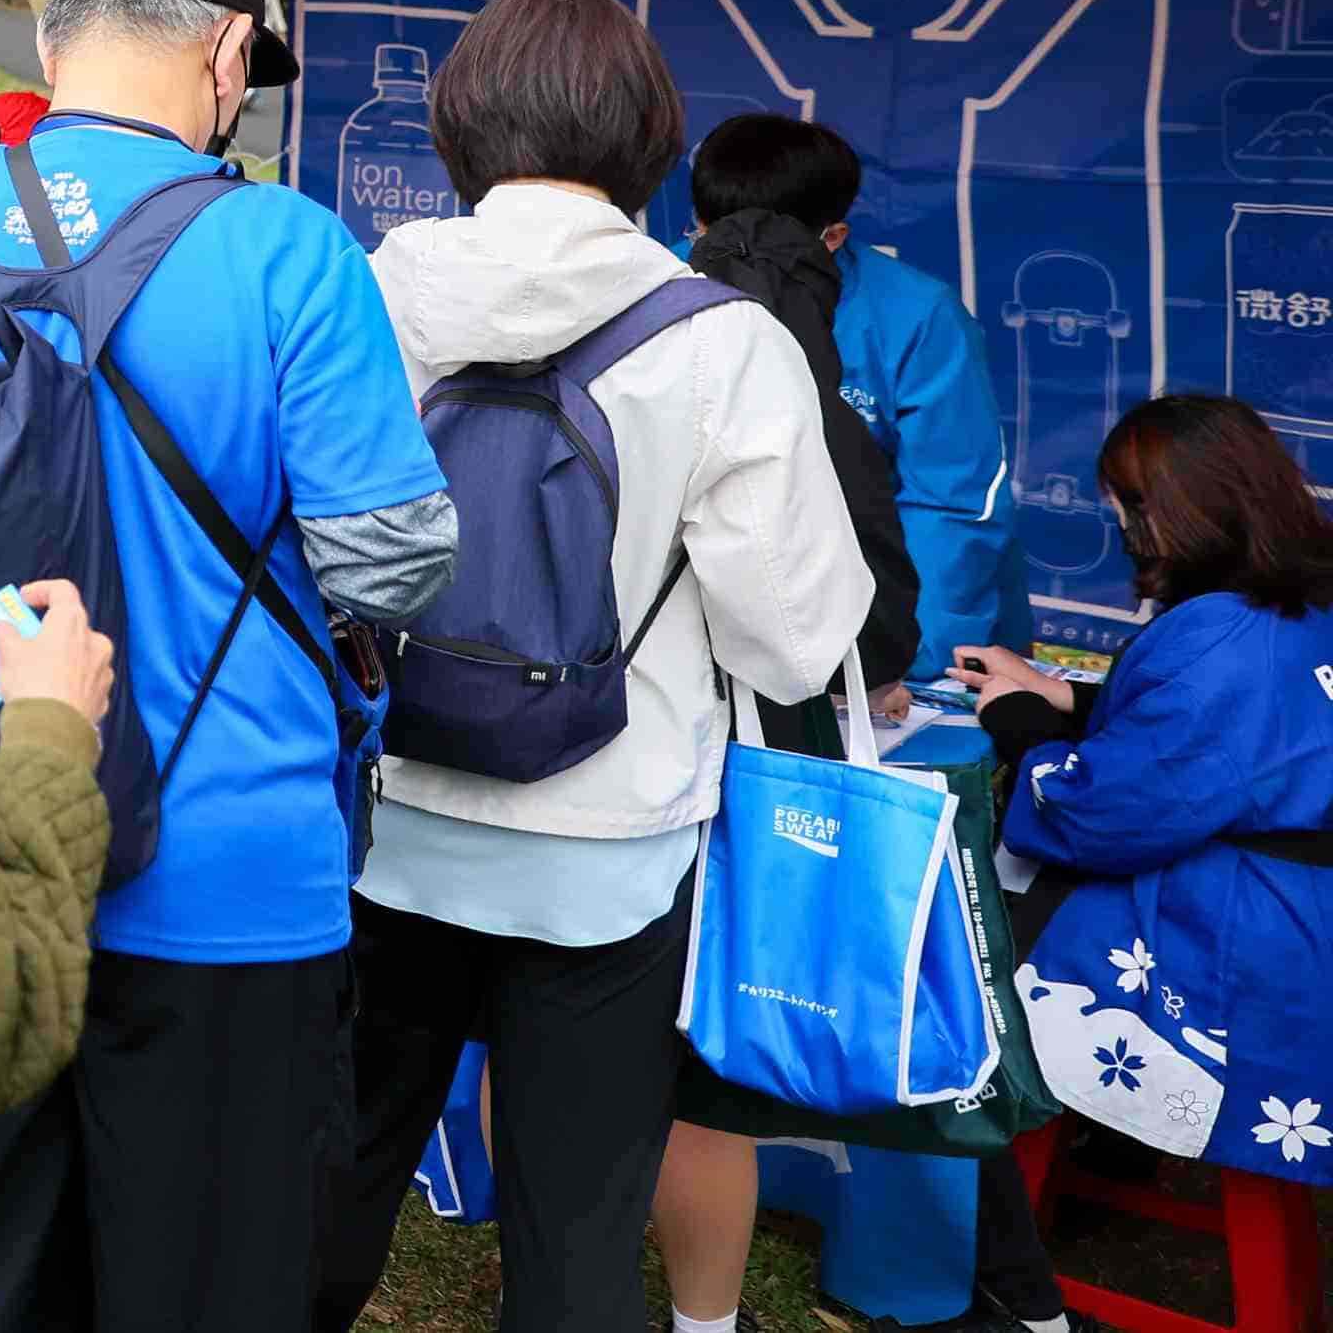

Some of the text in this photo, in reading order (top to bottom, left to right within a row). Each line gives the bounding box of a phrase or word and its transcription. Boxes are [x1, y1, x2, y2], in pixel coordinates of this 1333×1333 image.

[353, 158, 393, 187] ion
[351, 185, 449, 213] water
[773, 820, 835, 843] SWEAT
[774, 808, 841, 834] POCARI
